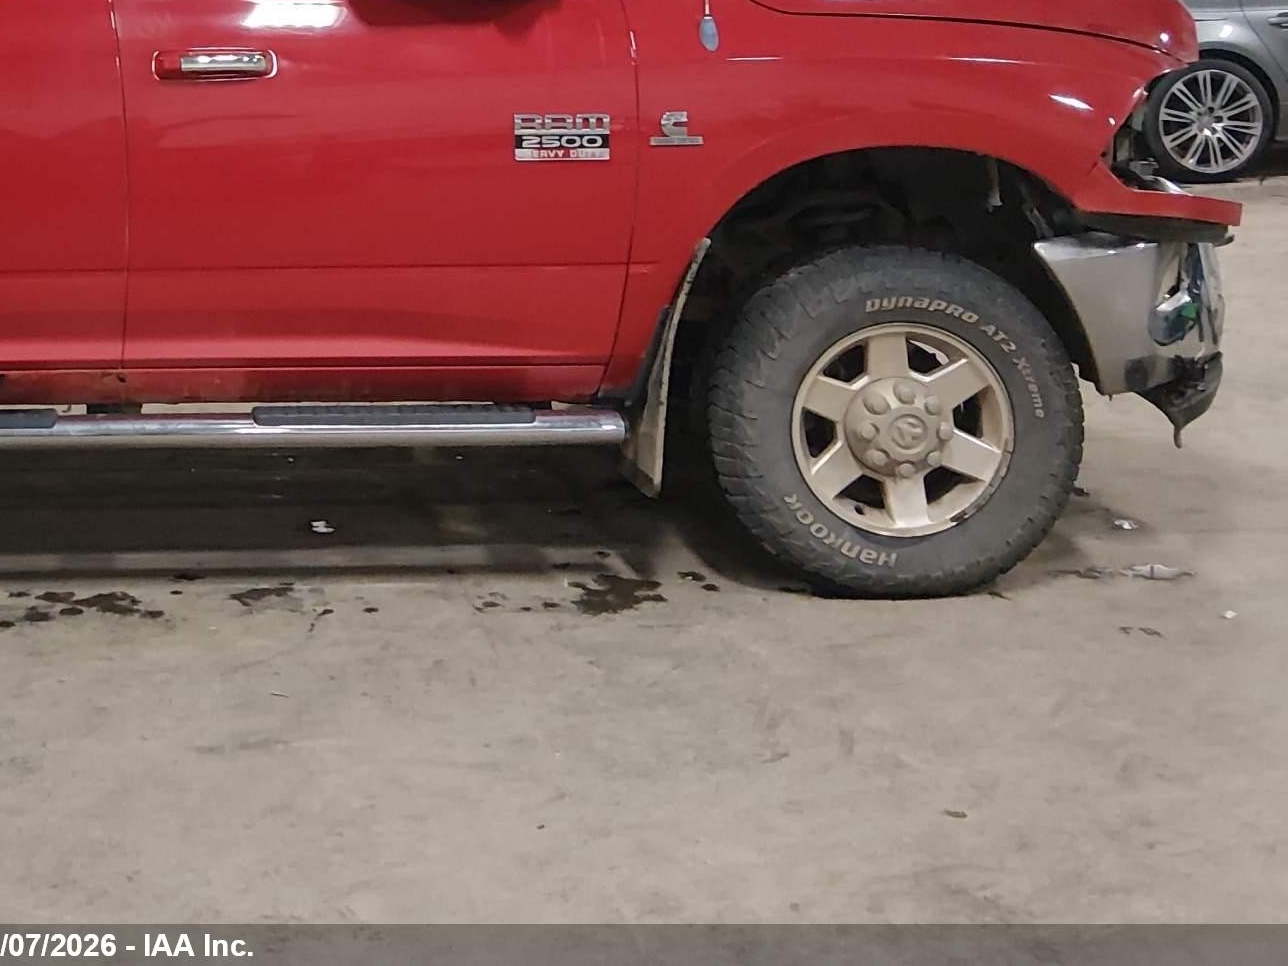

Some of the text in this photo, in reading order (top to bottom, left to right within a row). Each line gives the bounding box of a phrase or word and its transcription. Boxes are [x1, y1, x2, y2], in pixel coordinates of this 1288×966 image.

[514, 114, 610, 130] RAM
[521, 136, 603, 147] 2500
[523, 149, 566, 158] EAVY
[980, 323, 1016, 354] AT2
[1012, 357, 1045, 419] Xtreme
